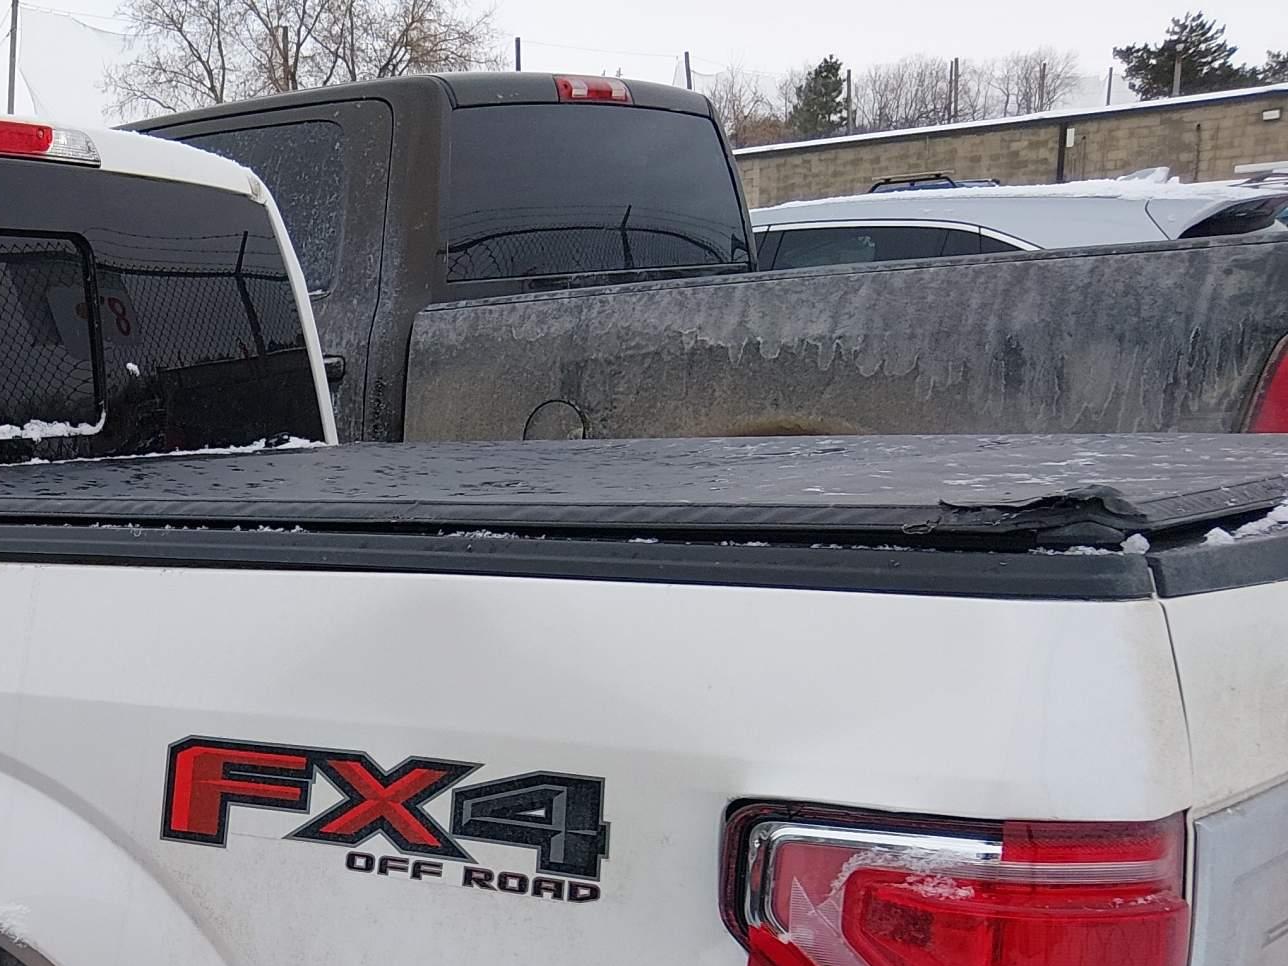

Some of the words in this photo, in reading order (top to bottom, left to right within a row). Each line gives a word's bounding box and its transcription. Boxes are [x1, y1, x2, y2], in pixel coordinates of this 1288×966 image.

[160, 735, 610, 881] FX4
[345, 851, 443, 880] OFF
[463, 865, 601, 902] ROAD
